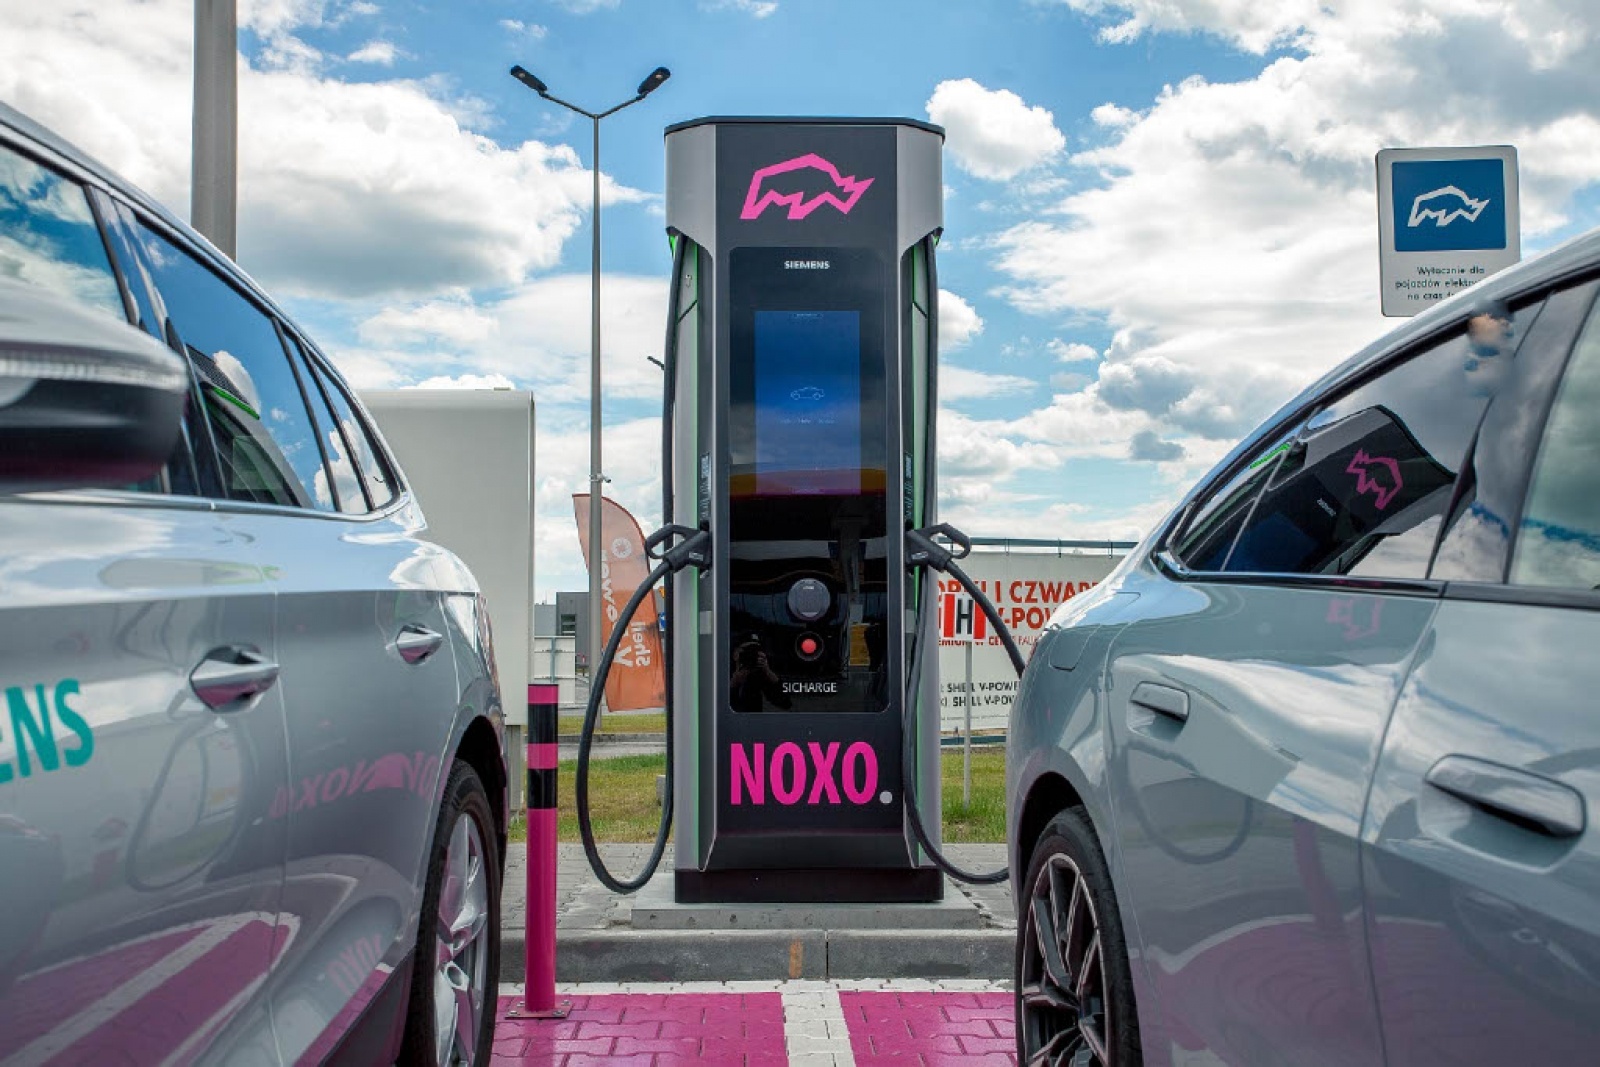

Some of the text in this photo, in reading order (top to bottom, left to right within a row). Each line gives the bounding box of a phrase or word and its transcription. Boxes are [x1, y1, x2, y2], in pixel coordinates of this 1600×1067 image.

[784, 260, 830, 269] SIEMENS
[1470, 265, 1485, 274] dla
[1395, 278, 1440, 290] pojazdów
[956, 598, 973, 634] H
[782, 681, 838, 693] SICHARGE
[946, 682, 976, 693] SHEL
[953, 695, 981, 707] SHLL
